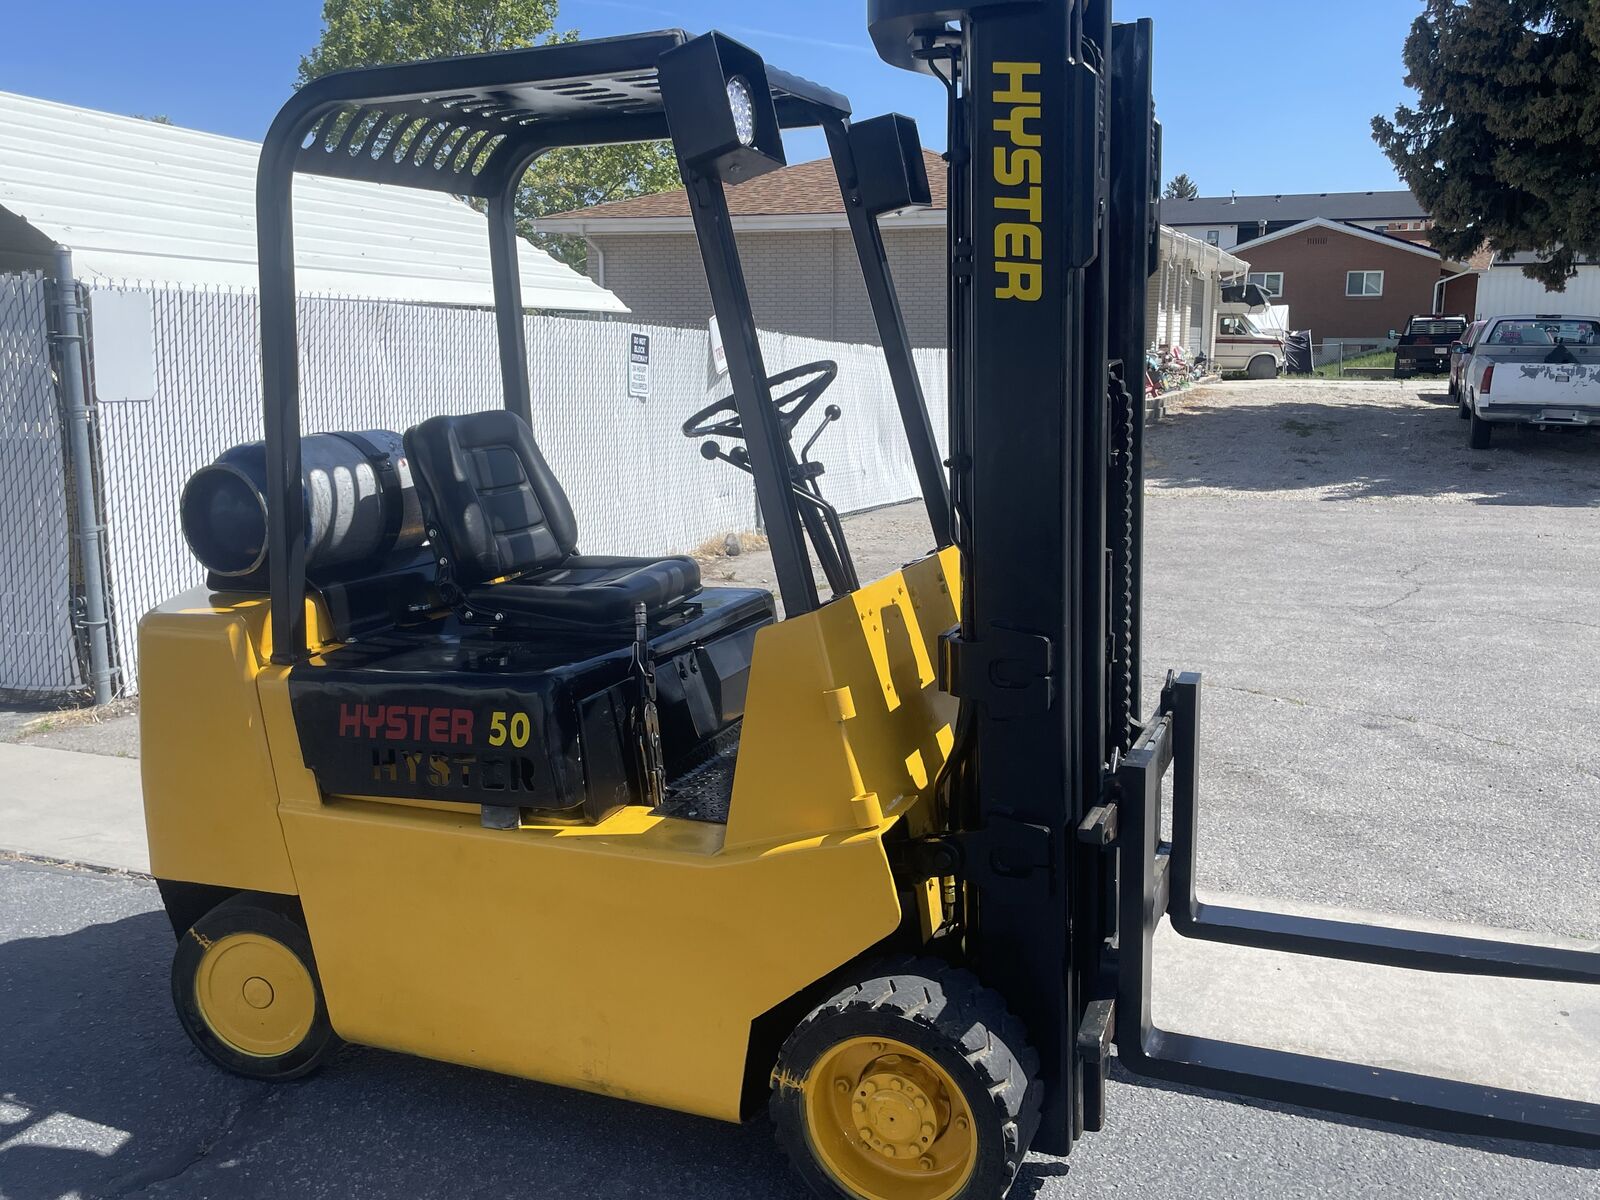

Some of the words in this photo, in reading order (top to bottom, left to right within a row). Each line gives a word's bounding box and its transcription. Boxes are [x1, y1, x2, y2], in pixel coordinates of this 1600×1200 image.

[992, 61, 1043, 302] HYSTER
[634, 345, 646, 354] BLOCK
[633, 373, 646, 382] ACCESS
[339, 703, 474, 745] HYSTER
[488, 711, 531, 748] 50
[371, 749, 536, 793] HYSTER
